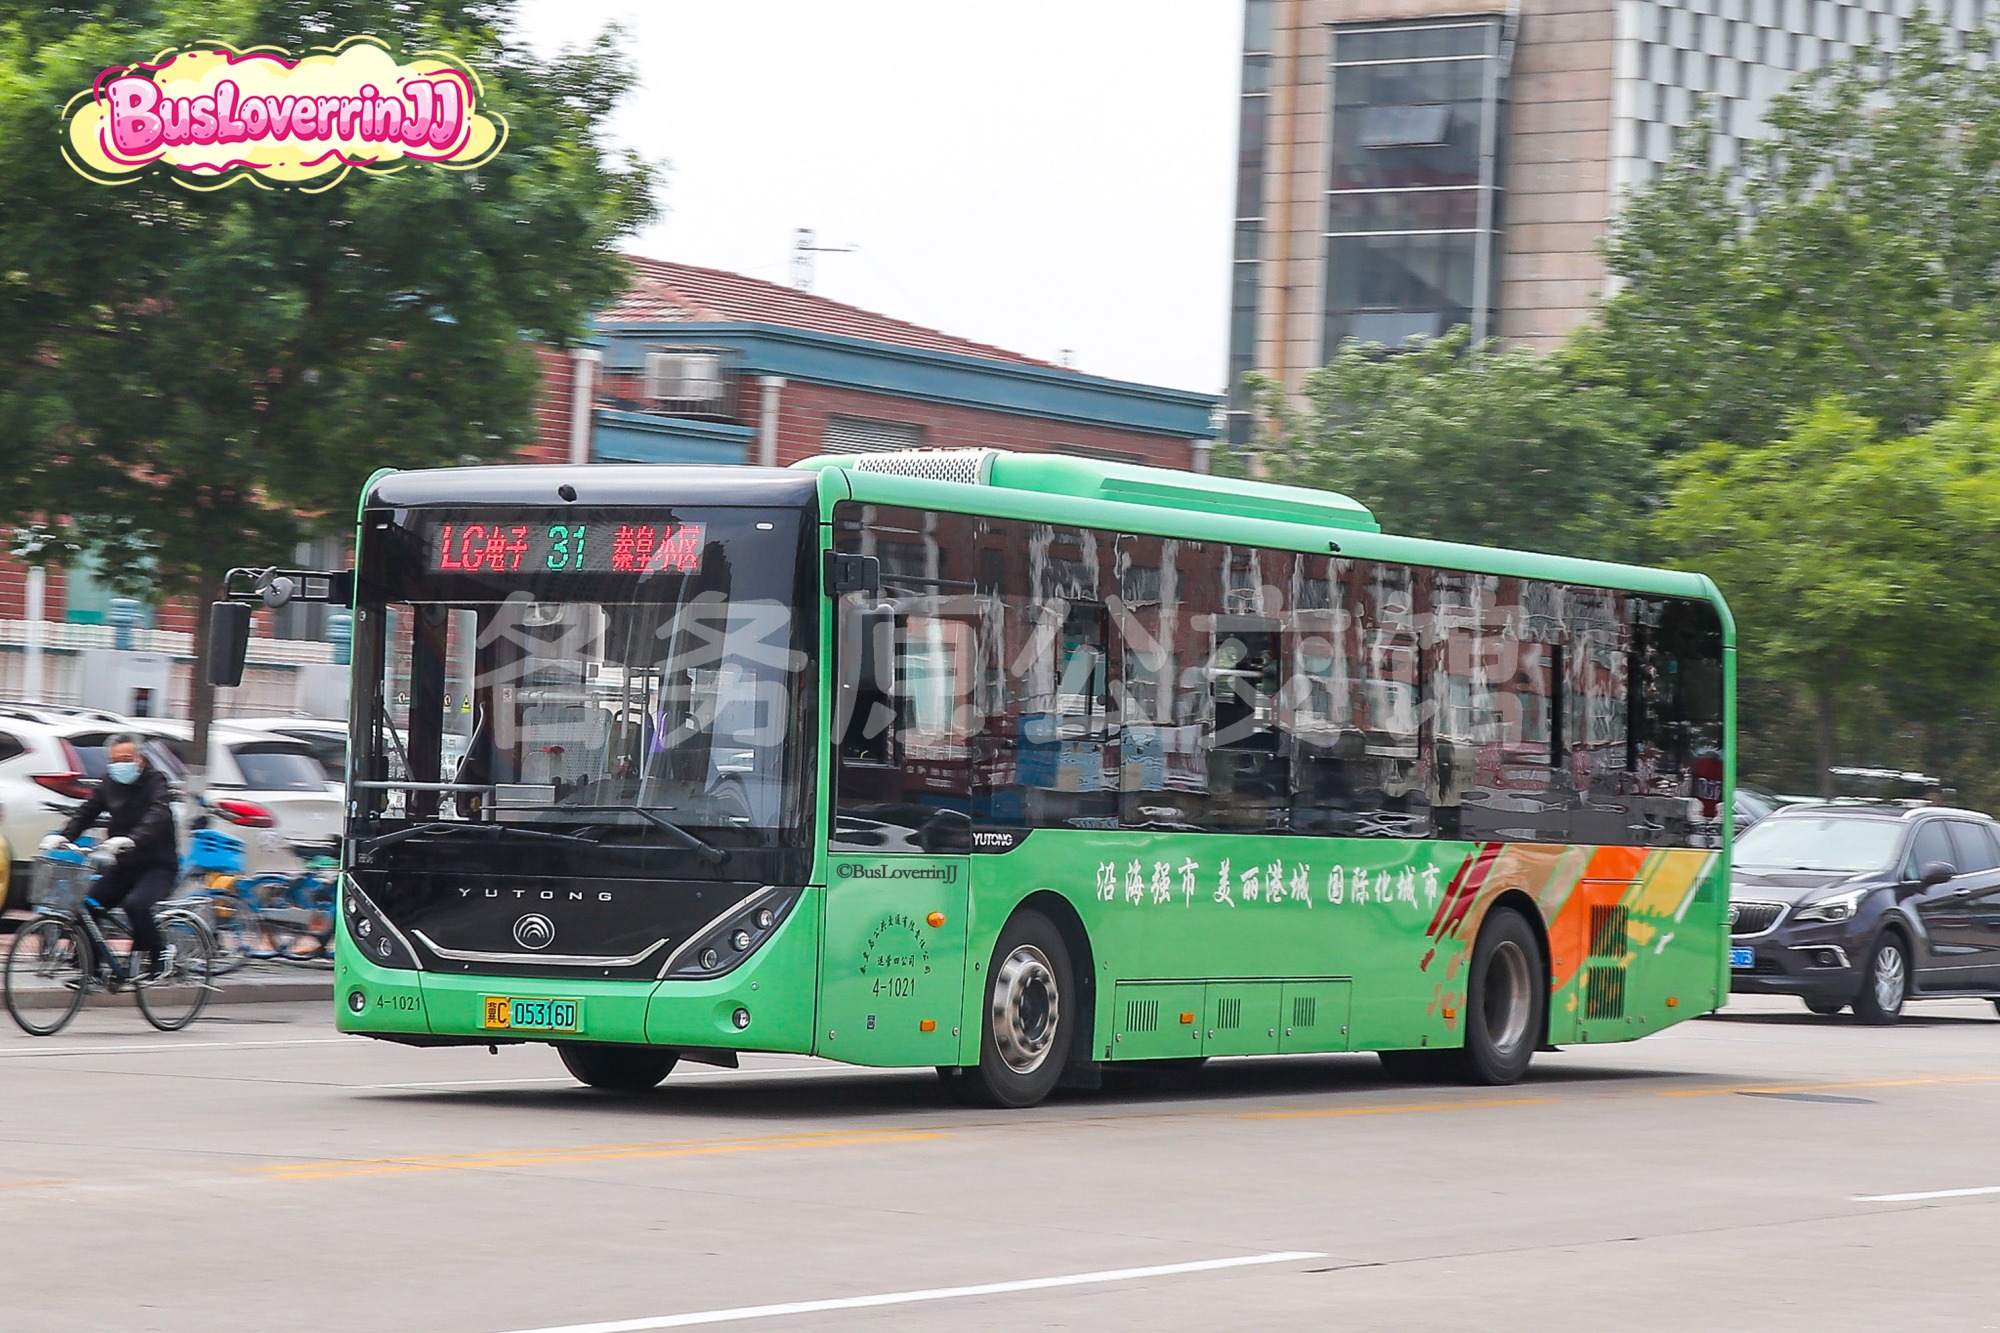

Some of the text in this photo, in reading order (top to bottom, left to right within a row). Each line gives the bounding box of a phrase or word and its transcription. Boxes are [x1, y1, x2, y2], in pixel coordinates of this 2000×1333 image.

[546, 525, 587, 572] 31
[972, 832, 1013, 846] YUTONG
[1096, 857, 1441, 910] 沿海强市 美丽港城 国际化城市
[458, 888, 613, 901] YUTONG
[872, 978, 915, 997] 4-1021
[376, 995, 421, 1011] 4-1021
